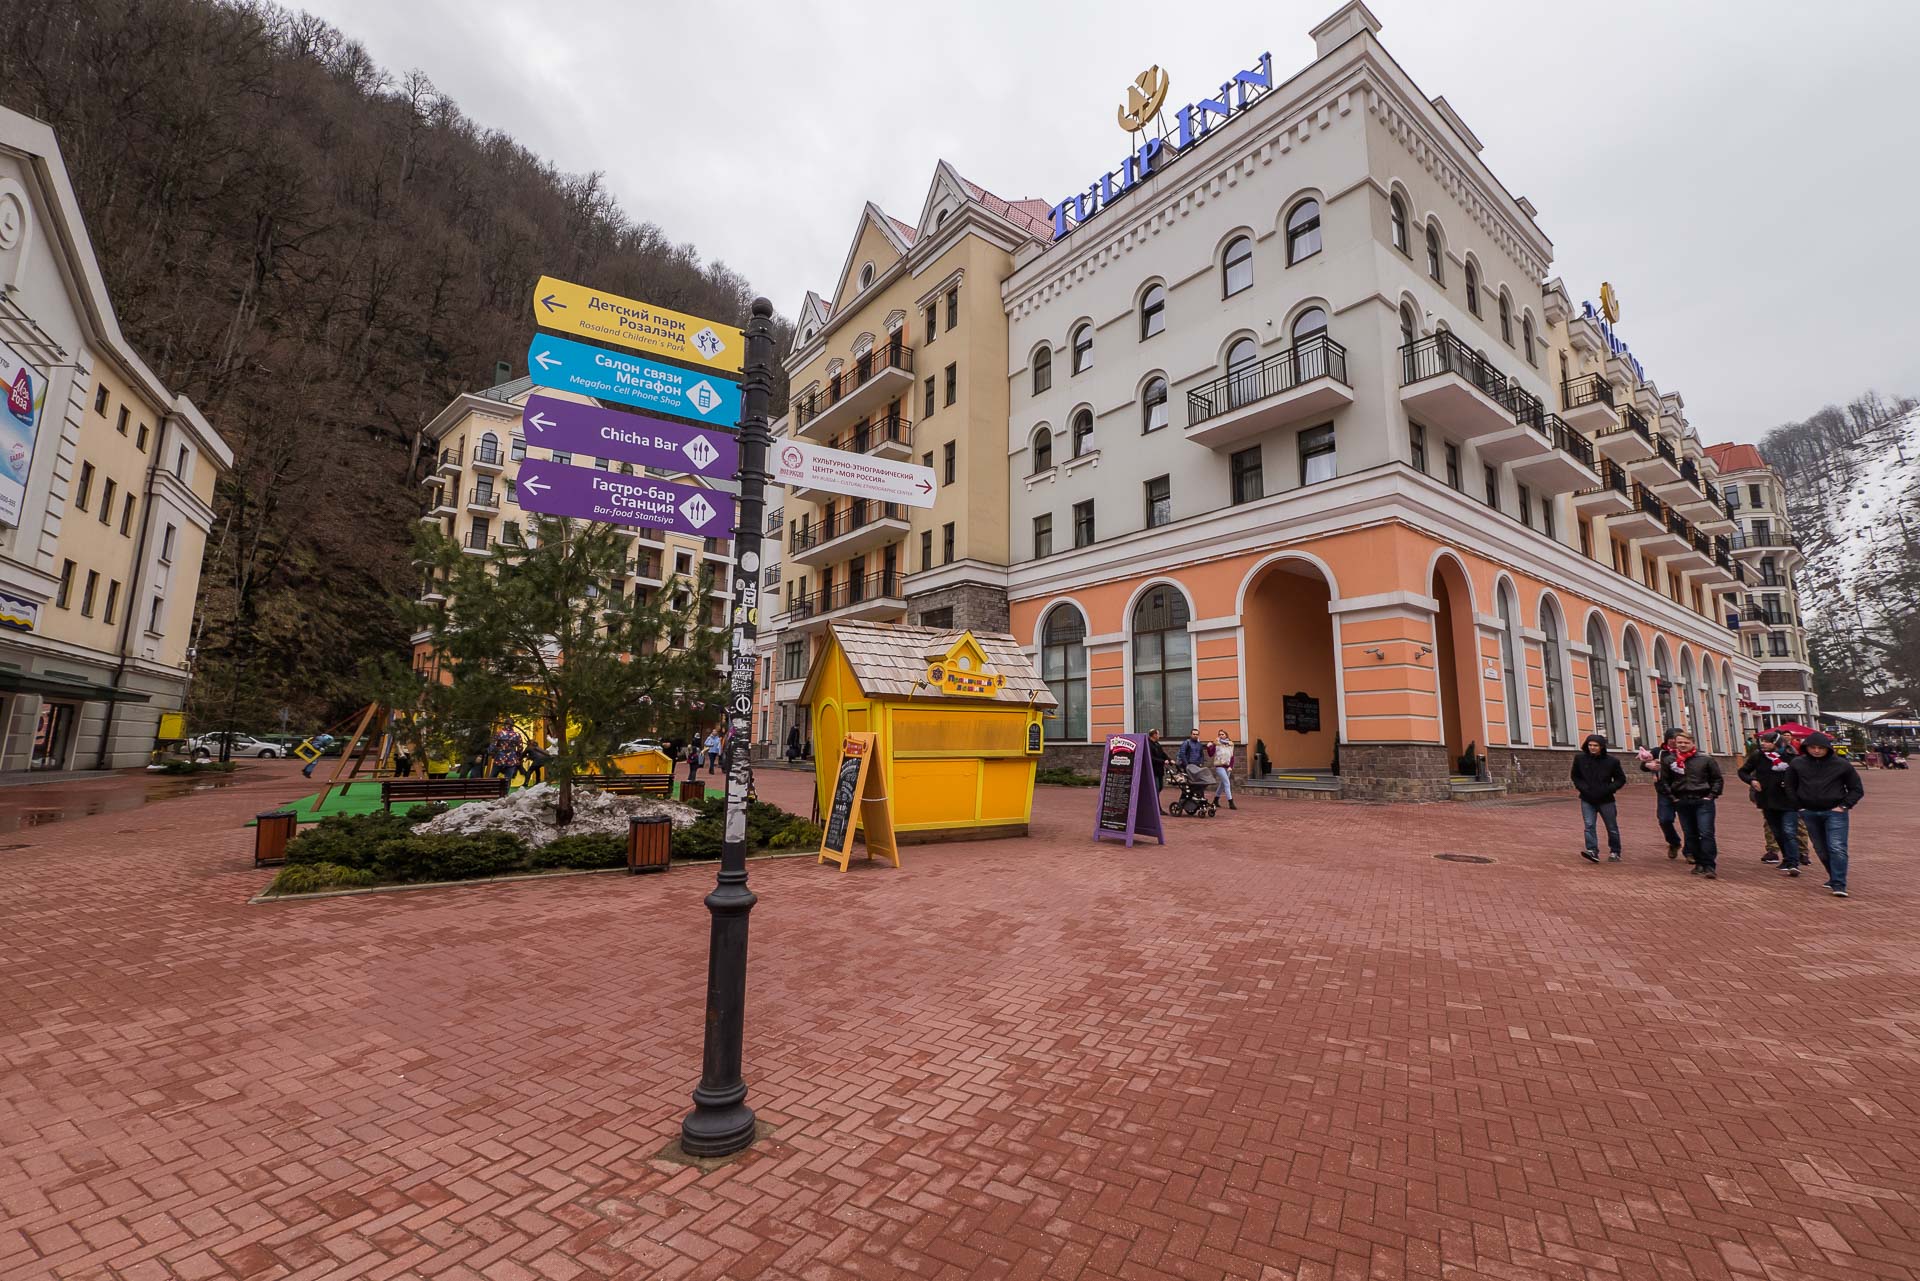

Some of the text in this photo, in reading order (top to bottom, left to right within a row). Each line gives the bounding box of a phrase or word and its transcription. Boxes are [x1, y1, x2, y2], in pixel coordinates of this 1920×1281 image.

[1047, 51, 1272, 241] TULIP INN
[588, 296, 686, 331] Детский парк
[579, 320, 621, 337] Rosaland
[666, 342, 685, 352] Park
[619, 316, 686, 344] Розалэнд
[595, 353, 682, 385] Салон связи
[569, 375, 681, 408] Megafon Cell Phone Shop
[616, 371, 681, 396] Мегафон
[11, 388, 28, 411] Роза
[600, 427, 678, 452] Chicha Bar
[812, 456, 914, 481] КУЛЬТУРНО-ЭТНОГРАФИЧЕСКИЙ
[812, 465, 834, 475] ЦЕНТР
[592, 477, 675, 503] Гастро-бар
[593, 505, 674, 525] Bar-food Stantsiya
[611, 493, 675, 514] Станция
